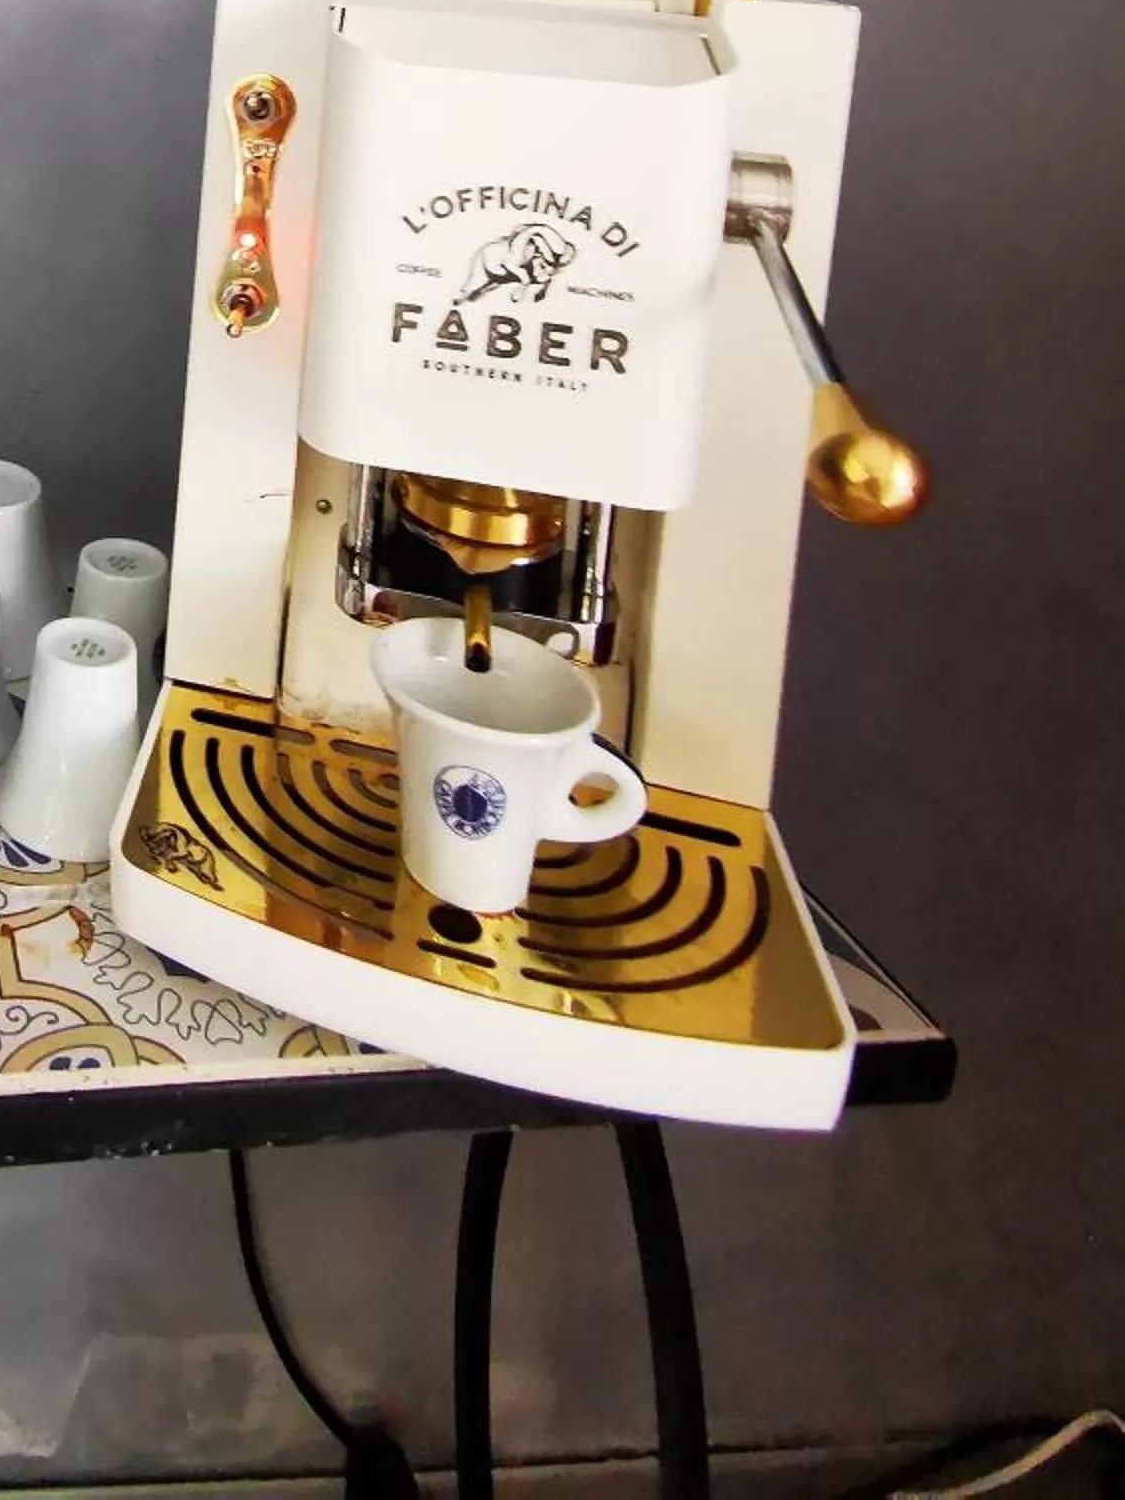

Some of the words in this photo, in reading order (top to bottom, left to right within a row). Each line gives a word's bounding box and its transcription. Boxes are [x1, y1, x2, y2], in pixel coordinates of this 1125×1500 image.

[402, 186, 593, 235] L'OFFICINA
[600, 221, 641, 258] DI
[391, 302, 628, 375] FABER
